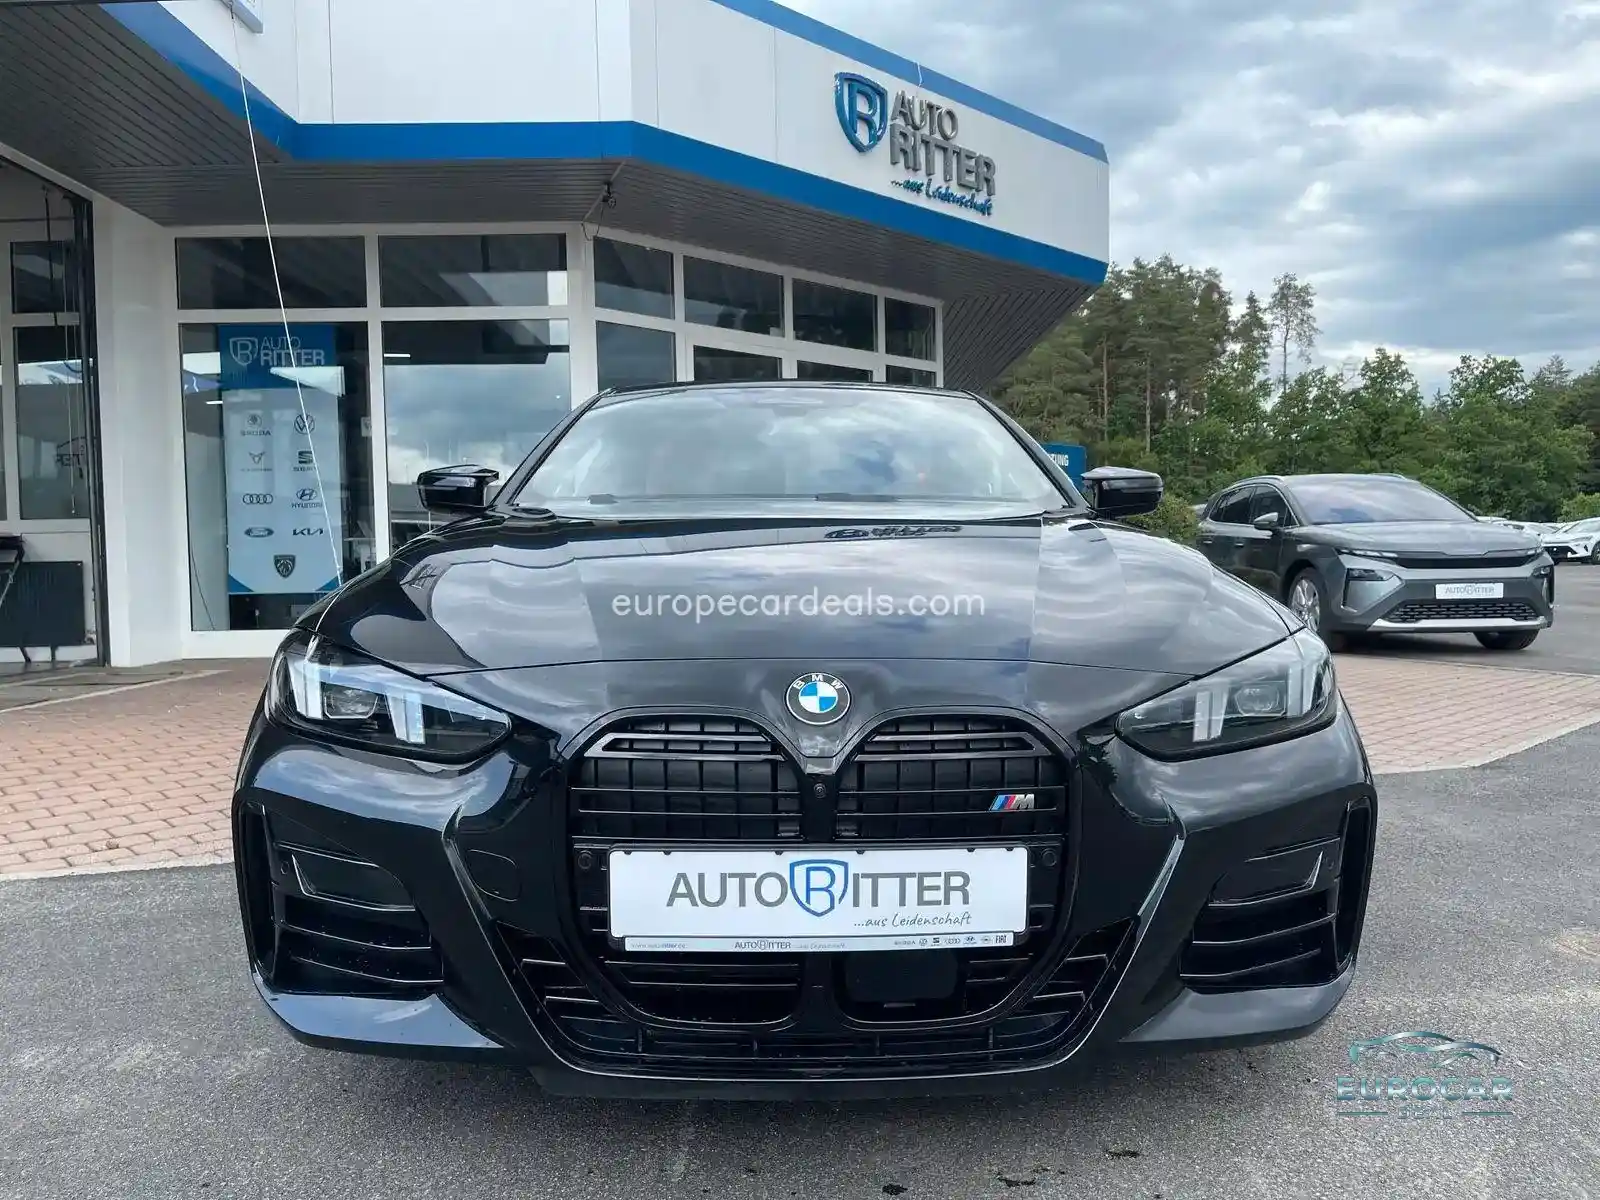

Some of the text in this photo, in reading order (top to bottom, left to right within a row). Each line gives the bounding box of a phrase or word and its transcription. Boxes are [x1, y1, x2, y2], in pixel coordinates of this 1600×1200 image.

[890, 90, 959, 140] AUTO
[889, 123, 996, 196] RITTER
[261, 336, 301, 350] AUTO
[260, 349, 325, 366] RITTER
[792, 674, 844, 690] BMW
[853, 911, 973, 928] ...aus Leidenschaft
